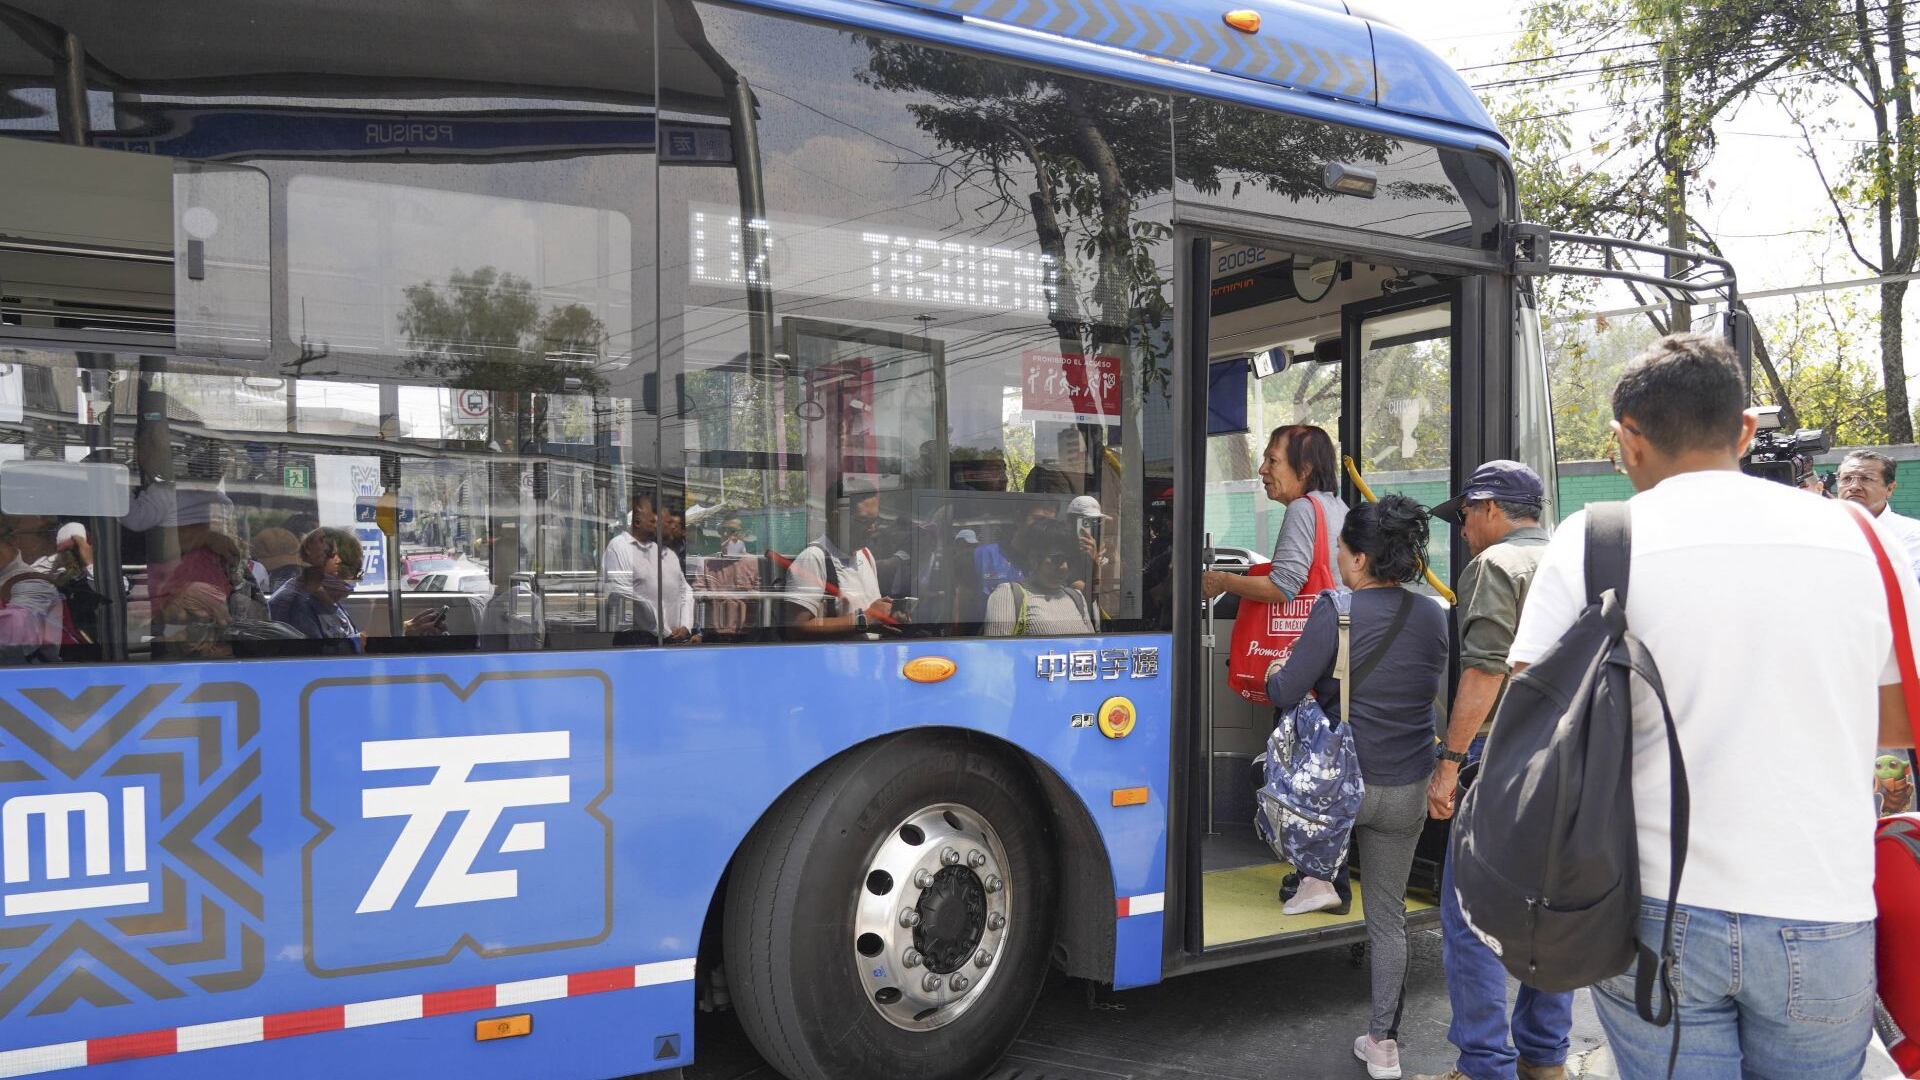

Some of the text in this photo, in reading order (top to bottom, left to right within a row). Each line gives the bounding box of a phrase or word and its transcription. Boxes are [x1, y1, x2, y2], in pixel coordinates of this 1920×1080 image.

[1218, 247, 1266, 273] 20092
[1032, 356, 1072, 365] PROHIBIDO
[1272, 599, 1314, 617] EL OUTLET
[1274, 620, 1284, 630] DE
[1036, 648, 1159, 682] 中国宇通
